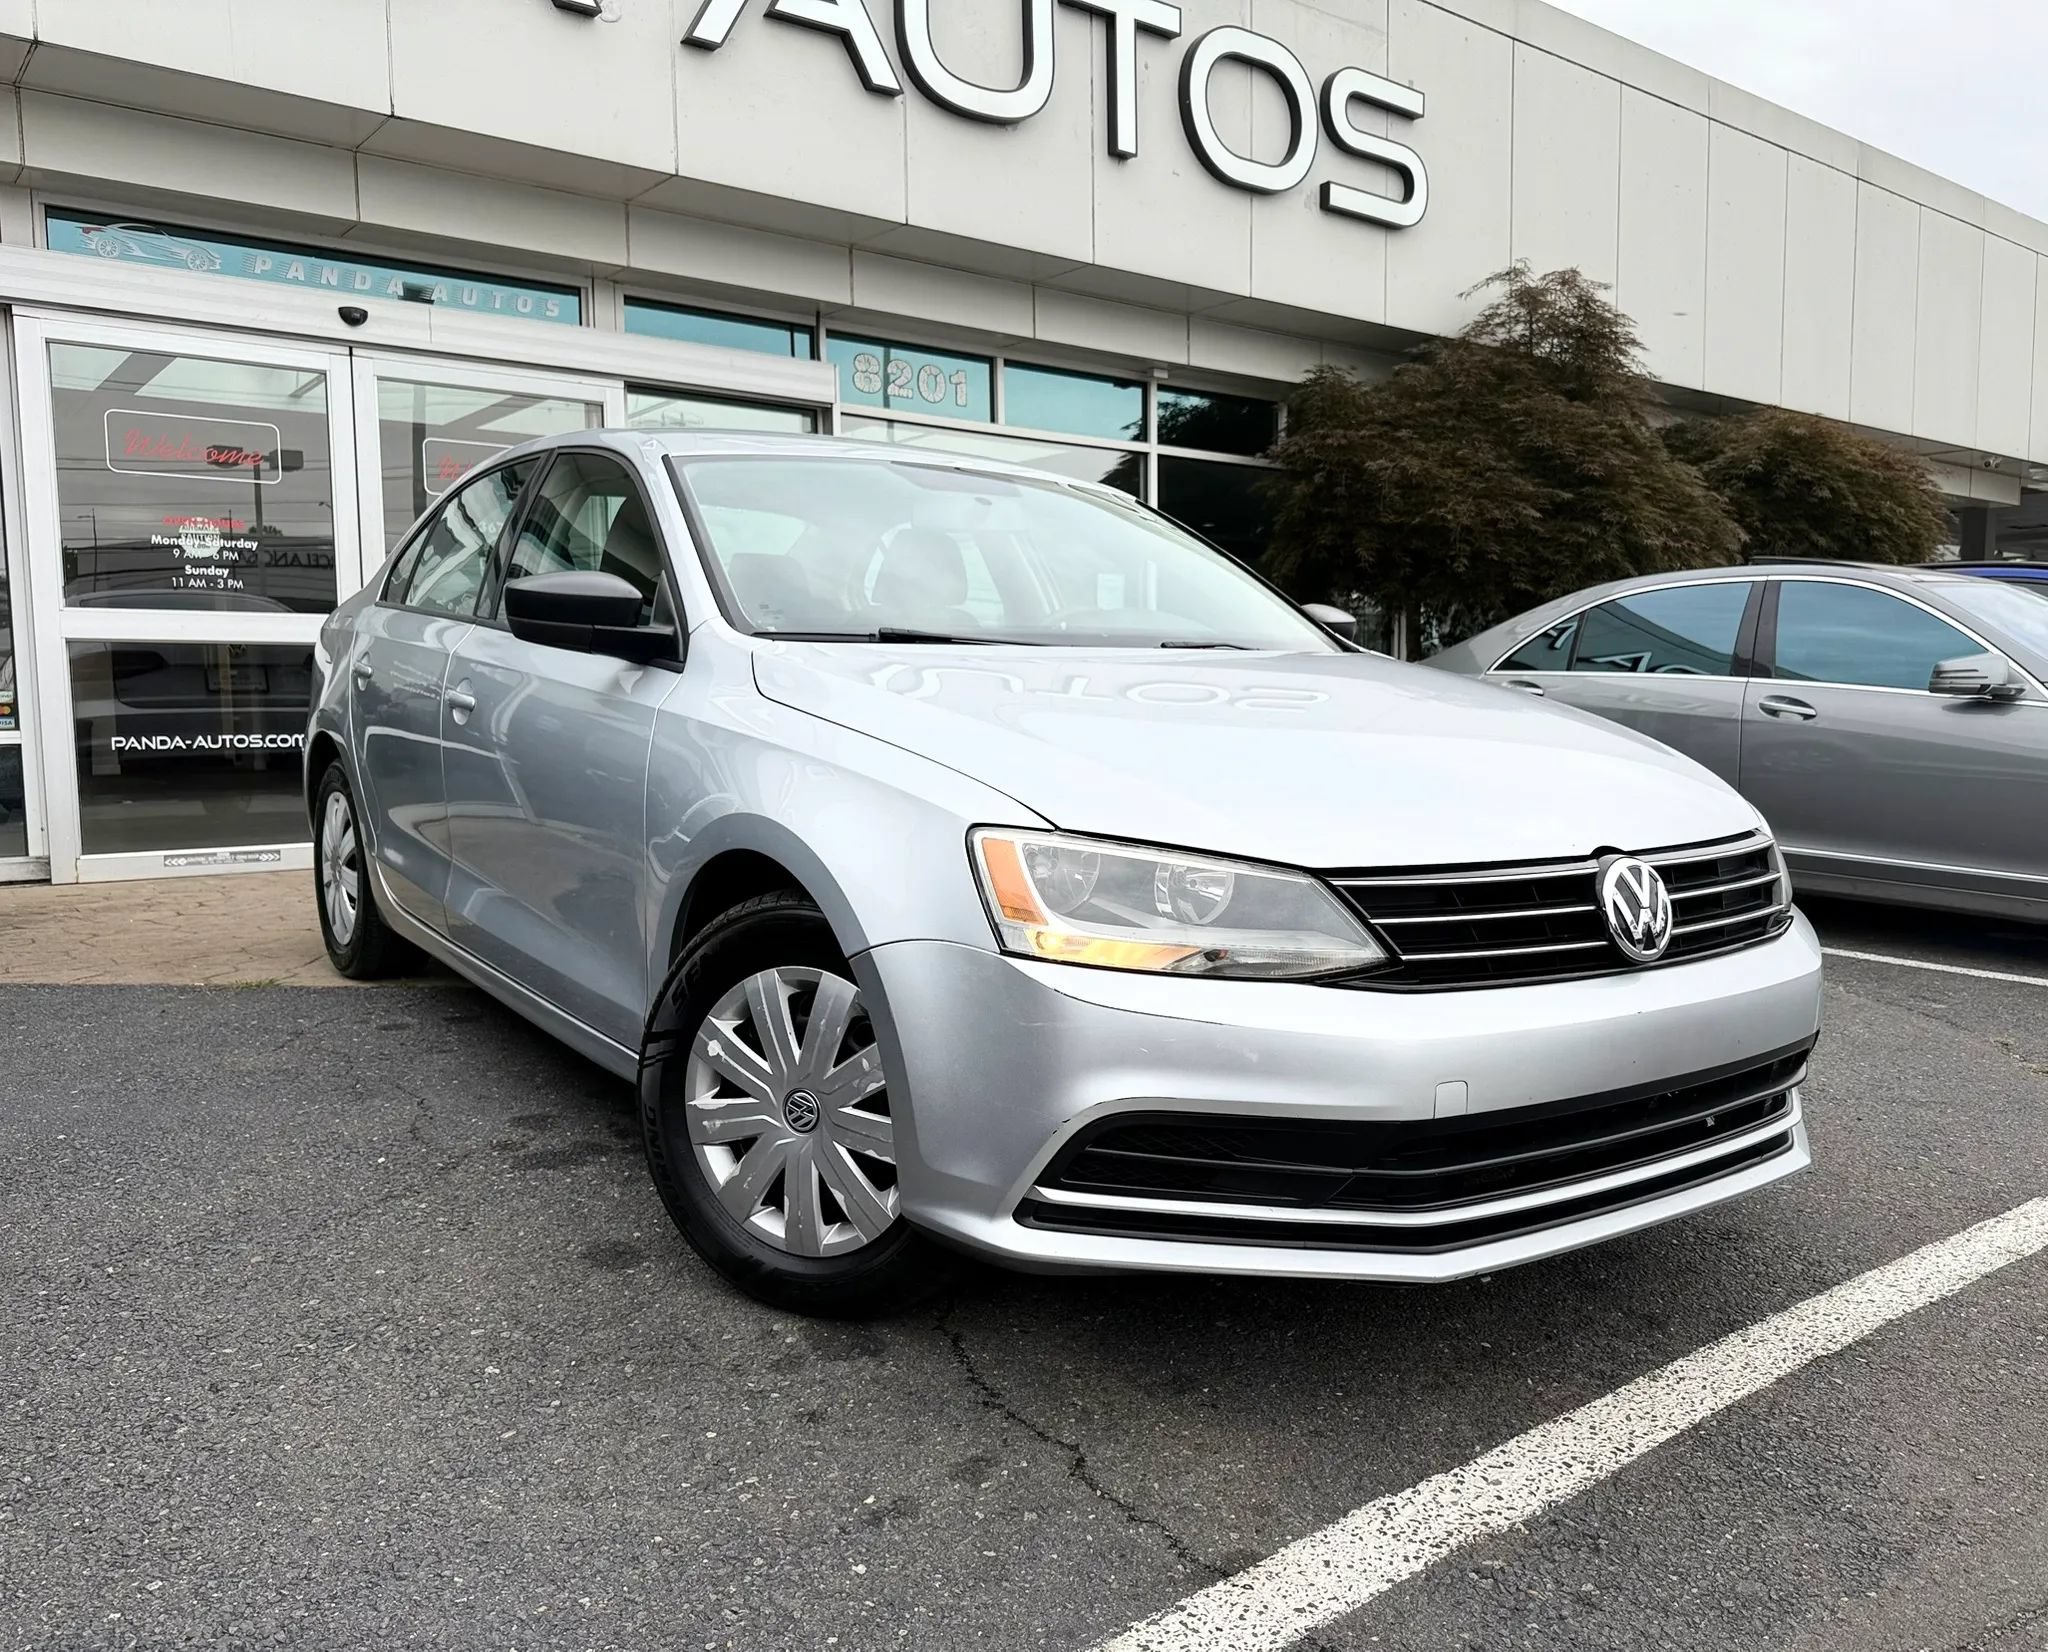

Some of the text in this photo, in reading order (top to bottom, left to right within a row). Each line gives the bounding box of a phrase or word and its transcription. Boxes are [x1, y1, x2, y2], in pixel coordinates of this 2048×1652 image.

[251, 255, 561, 318] PANDA AUTOS
[852, 353, 968, 408] 8201
[124, 427, 264, 466] Welcome
[173, 548, 180, 559] 9
[212, 550, 220, 560] 6
[223, 550, 239, 561] PM
[172, 577, 184, 588] 11
[188, 578, 207, 588] AM
[217, 579, 224, 589] 3
[227, 579, 244, 589] PM
[184, 564, 230, 578] Sunday
